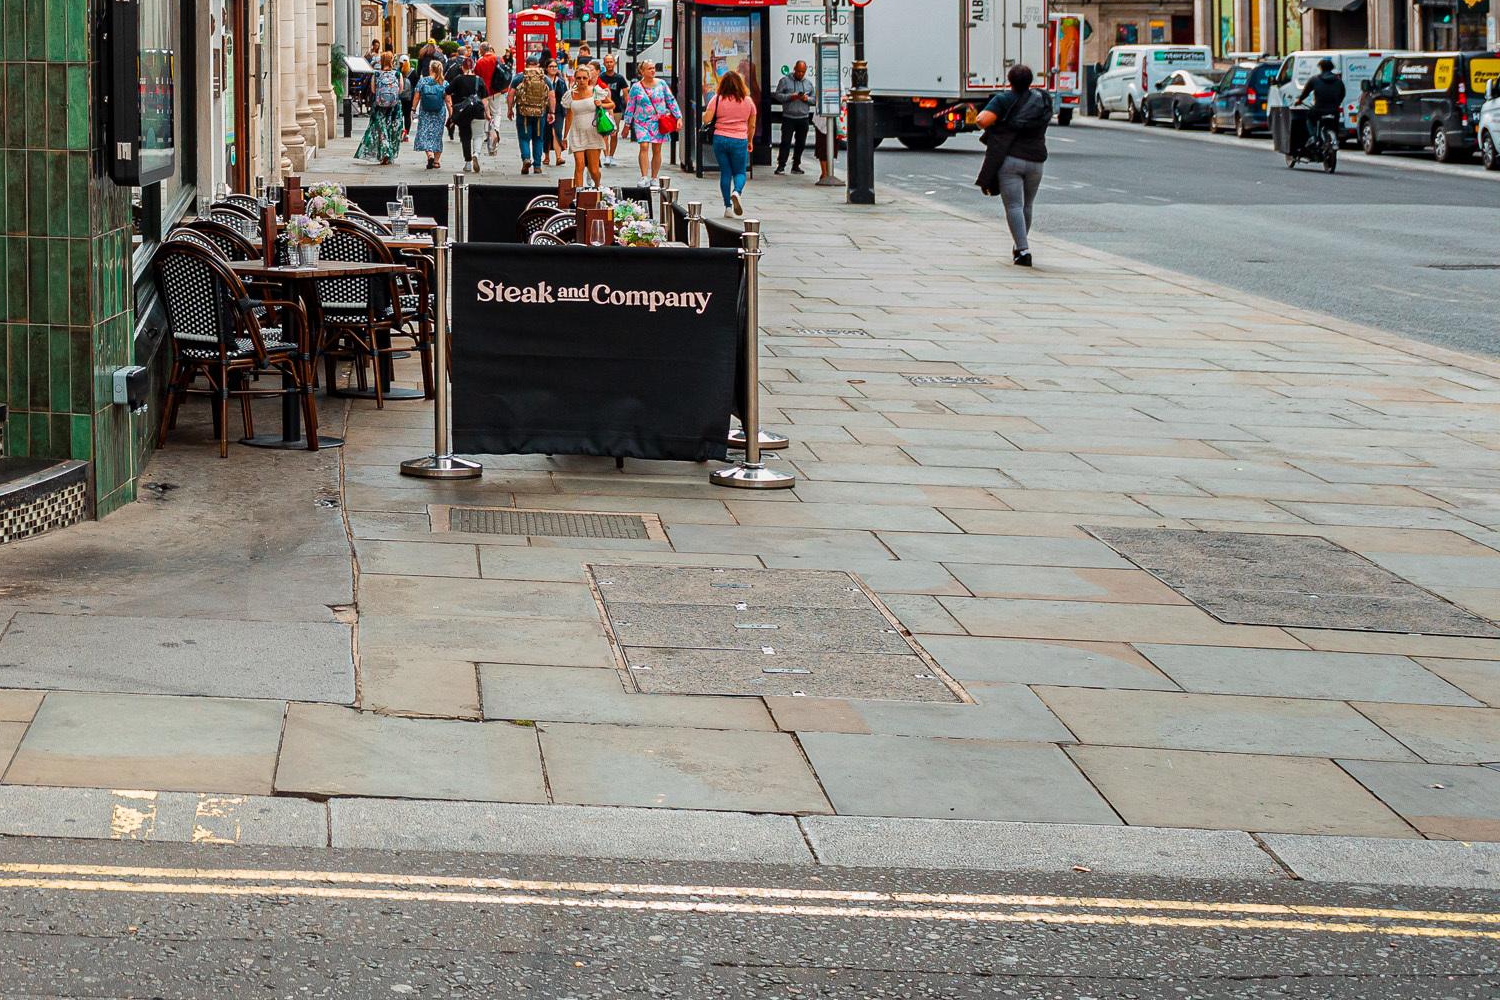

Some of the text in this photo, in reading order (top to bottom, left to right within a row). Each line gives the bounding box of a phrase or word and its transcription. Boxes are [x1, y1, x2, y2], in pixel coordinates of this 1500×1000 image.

[786, 15, 810, 26] FINE
[790, 33, 795, 43] 7
[476, 279, 713, 314] Steak and Company
